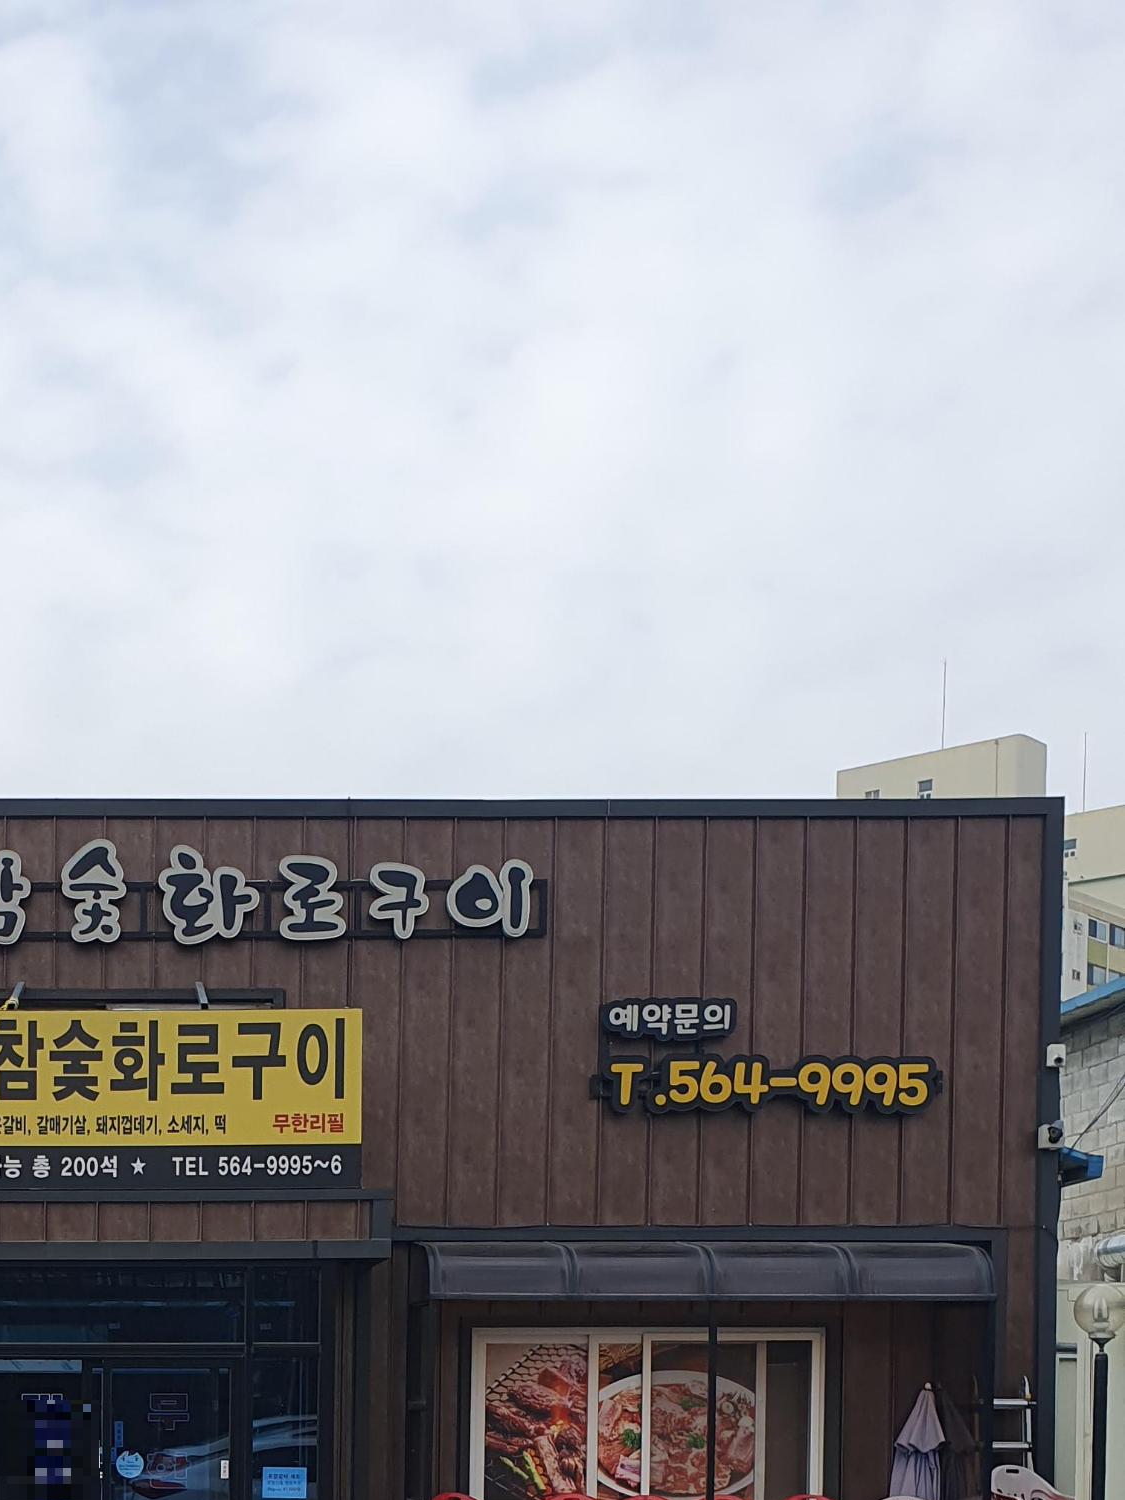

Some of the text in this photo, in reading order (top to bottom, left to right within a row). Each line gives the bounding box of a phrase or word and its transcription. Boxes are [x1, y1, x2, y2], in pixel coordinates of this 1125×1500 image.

[608, 1003, 732, 1036] 예약문의
[610, 1060, 930, 1106] T.564-9995
[37, 1114, 91, 1135] 갈매기살,
[95, 1114, 162, 1135] 돼지껍데기,
[167, 1114, 209, 1135] 소세지,
[215, 1114, 226, 1135] 떡
[272, 1113, 344, 1133] 무한리필
[32, 1155, 51, 1177] 총
[60, 1155, 118, 1177] 200석
[172, 1155, 342, 1176] TEL 564-9995~6
